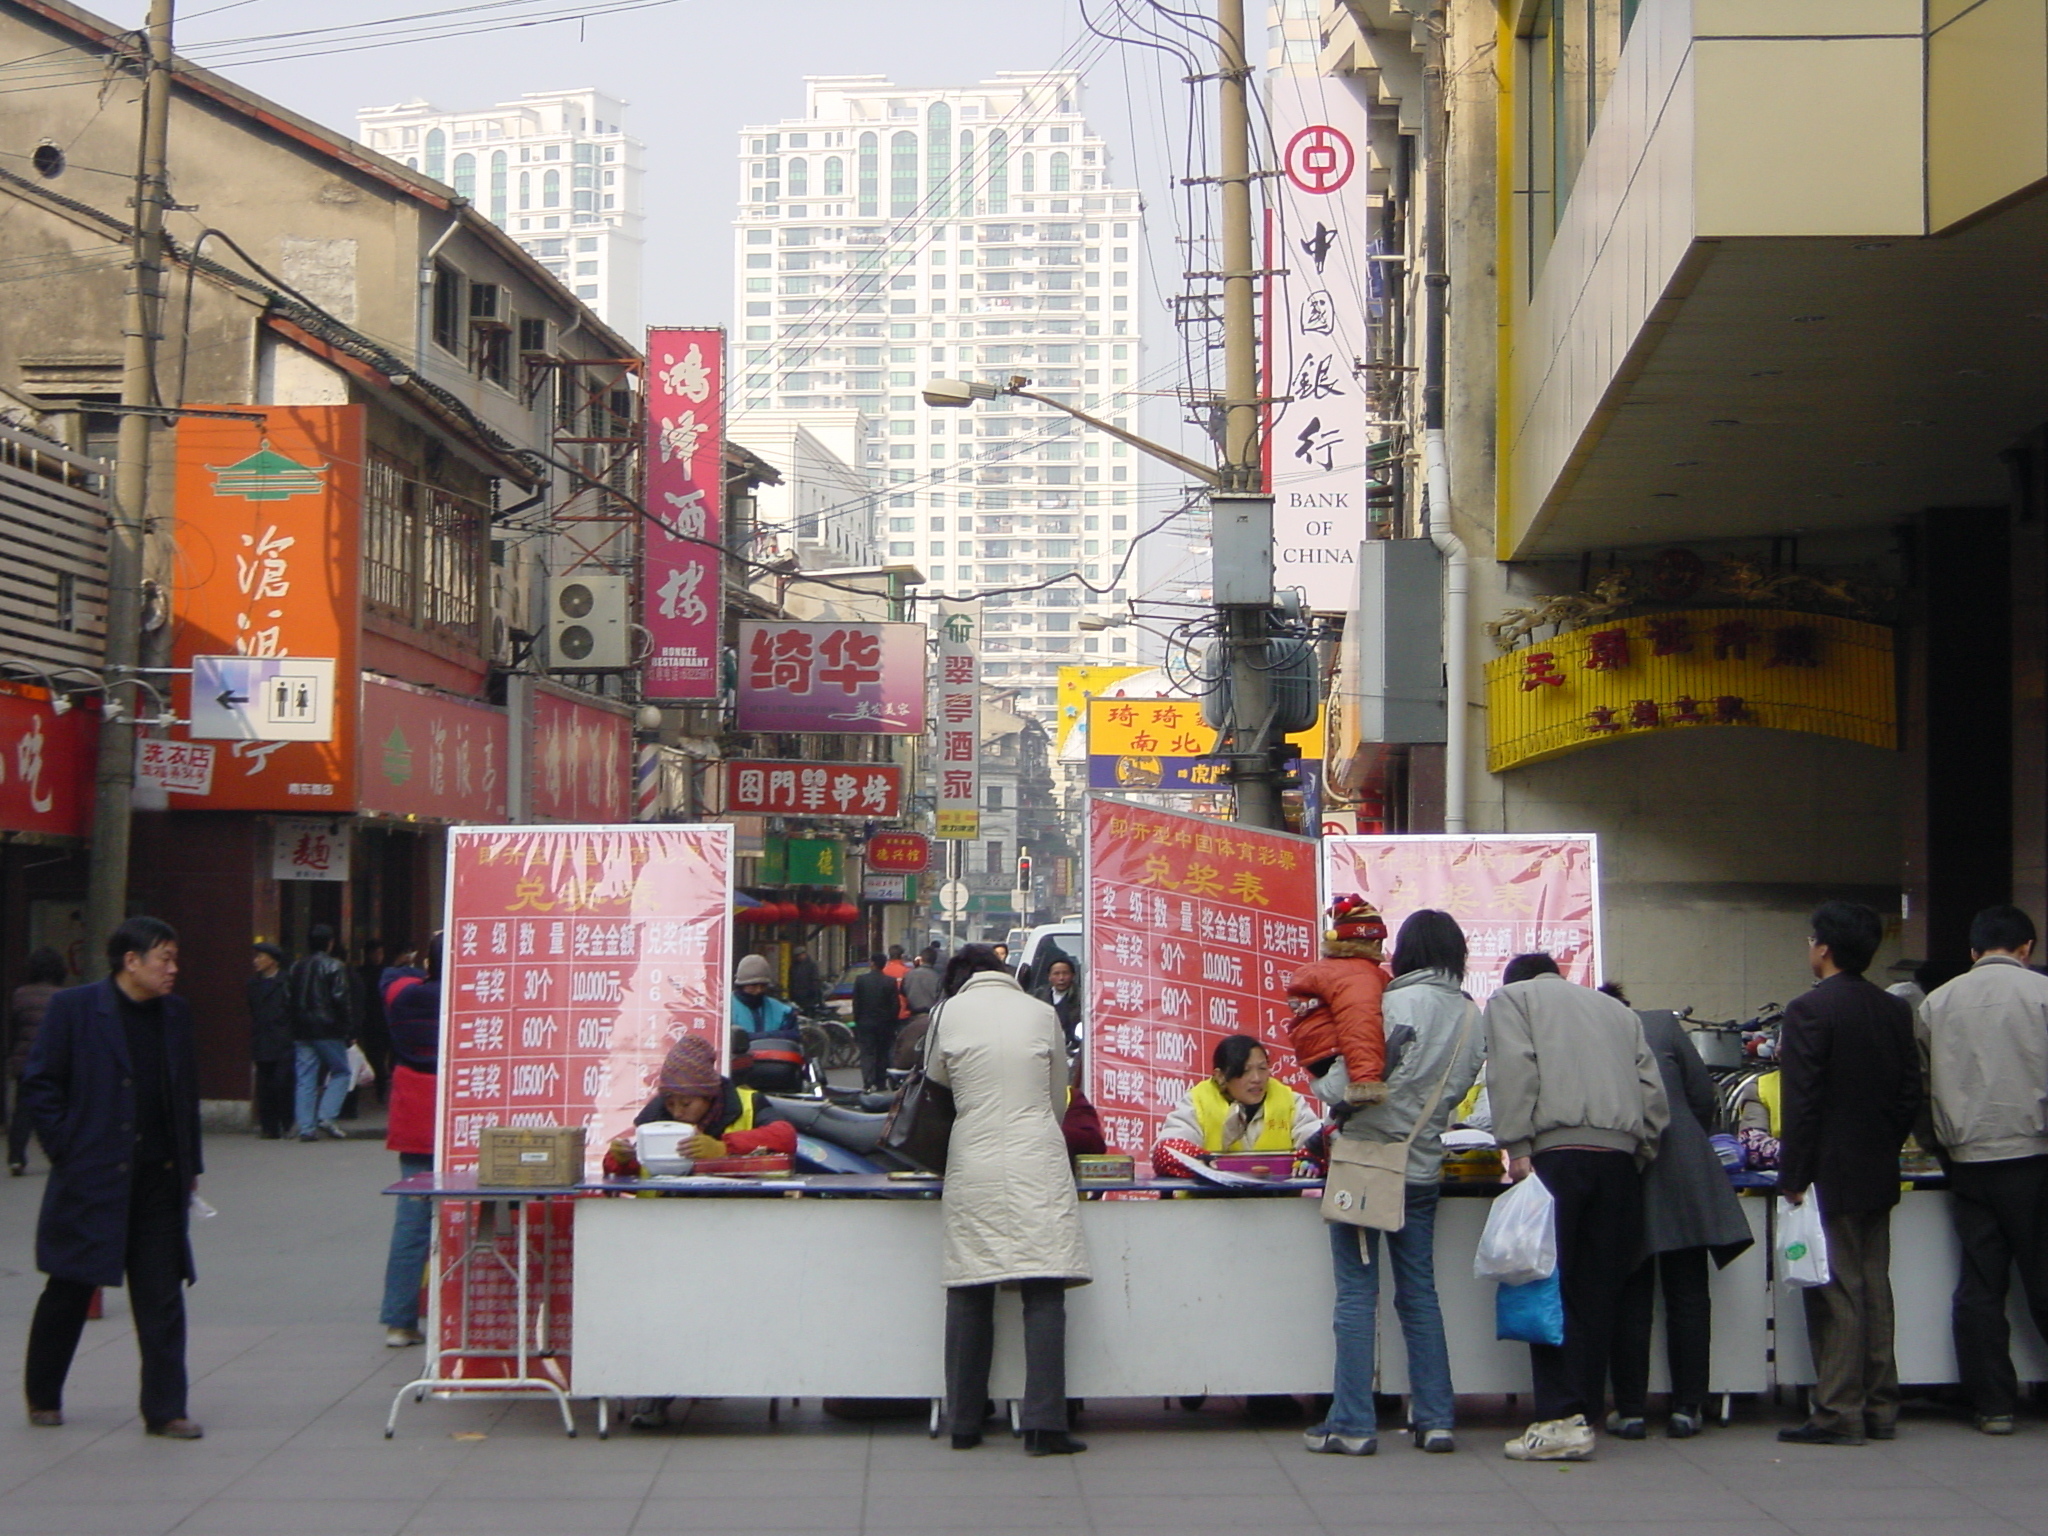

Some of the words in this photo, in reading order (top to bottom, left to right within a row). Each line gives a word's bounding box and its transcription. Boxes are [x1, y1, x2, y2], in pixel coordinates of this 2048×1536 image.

[1290, 493, 1349, 508] BANK
[1306, 522, 1333, 536] OF
[1283, 548, 1354, 564] CHINA
[652, 657, 709, 667] RESTAURANT
[751, 629, 881, 695] 绮华
[1109, 817, 1297, 871] 即开型中国体育彩票
[1137, 853, 1269, 905] 兑奖表
[575, 922, 635, 957] 奖金金额
[1102, 886, 1143, 924] 奖级
[1154, 895, 1194, 933] 数量
[1201, 906, 1251, 946] 奖金金额
[1263, 918, 1310, 959] 兑奖符号
[1102, 932, 1144, 968] 一等奖
[1161, 942, 1186, 976] 30个
[461, 968, 505, 1003] 一等奖
[524, 967, 553, 1002] 30个
[1102, 980, 1145, 1013] 二等奖
[1161, 987, 1192, 1021] 600个
[1210, 997, 1240, 1031] 600元
[461, 1017, 503, 1050] 二等奖
[523, 1015, 557, 1050] 600个
[578, 1018, 613, 1050] 600元
[1102, 1024, 1145, 1059] 三等奖
[1155, 1032, 1197, 1067] 10500个
[457, 1065, 501, 1098] 三等奖
[584, 1065, 613, 1097] 60元
[1102, 1069, 1145, 1104] 四等奖
[1103, 1115, 1145, 1151] 五等奖
